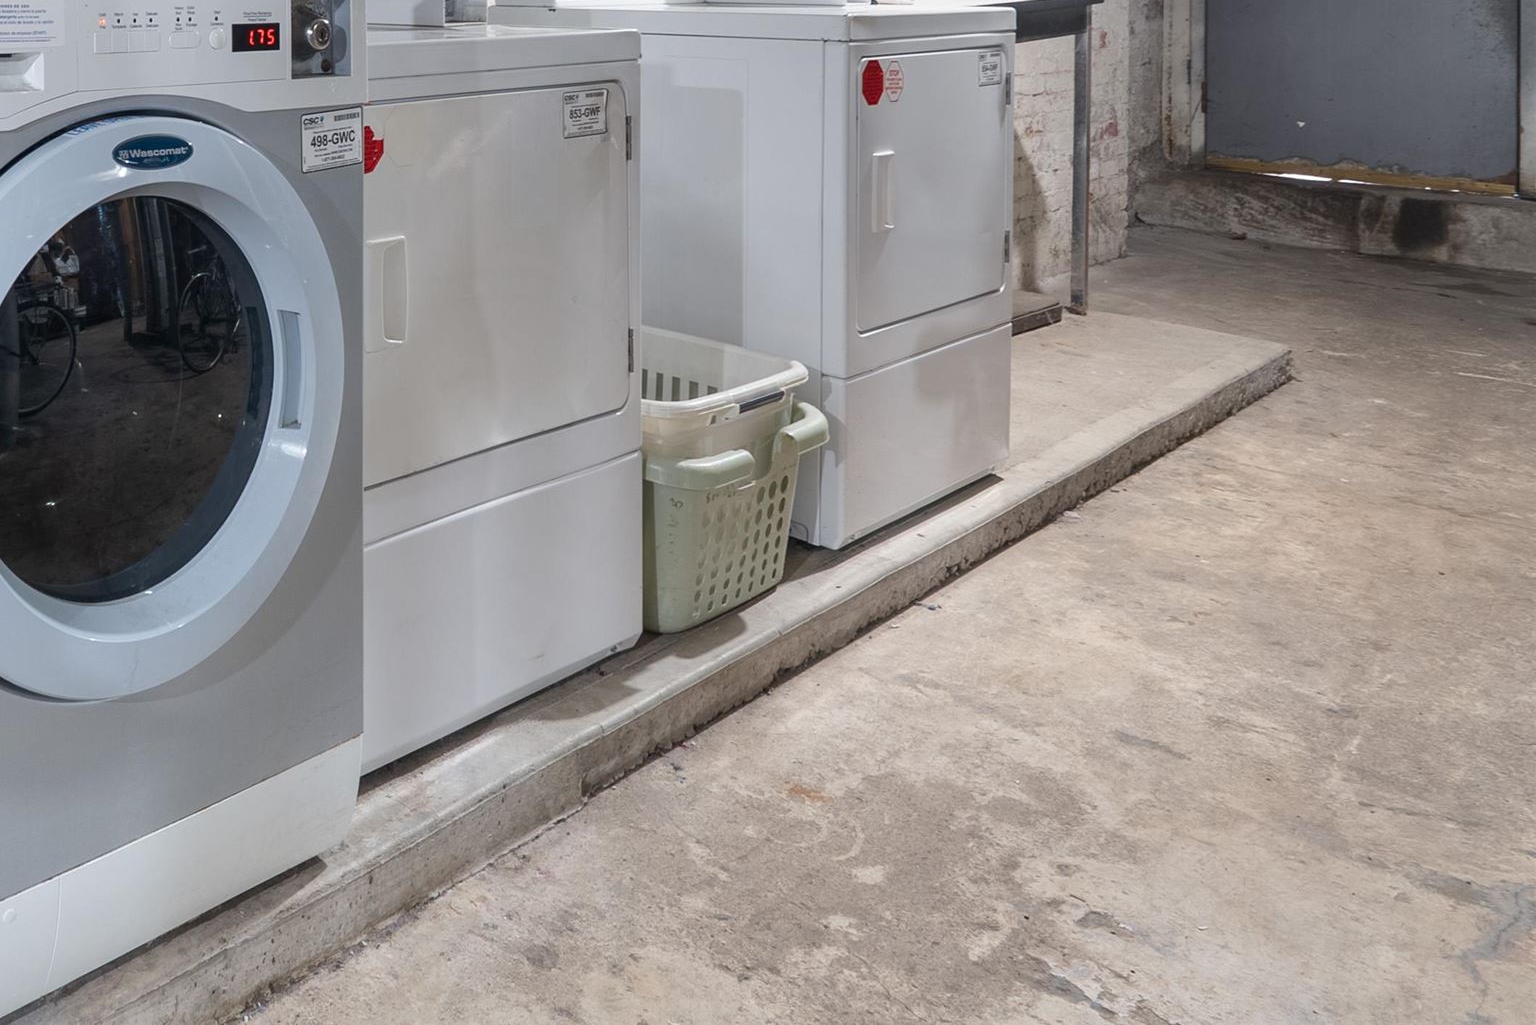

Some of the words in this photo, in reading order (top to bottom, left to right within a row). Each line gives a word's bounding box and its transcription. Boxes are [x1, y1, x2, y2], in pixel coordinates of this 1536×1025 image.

[303, 117, 319, 126] CSC
[310, 130, 356, 148] 498-GWC
[130, 147, 187, 159] Wascomat
